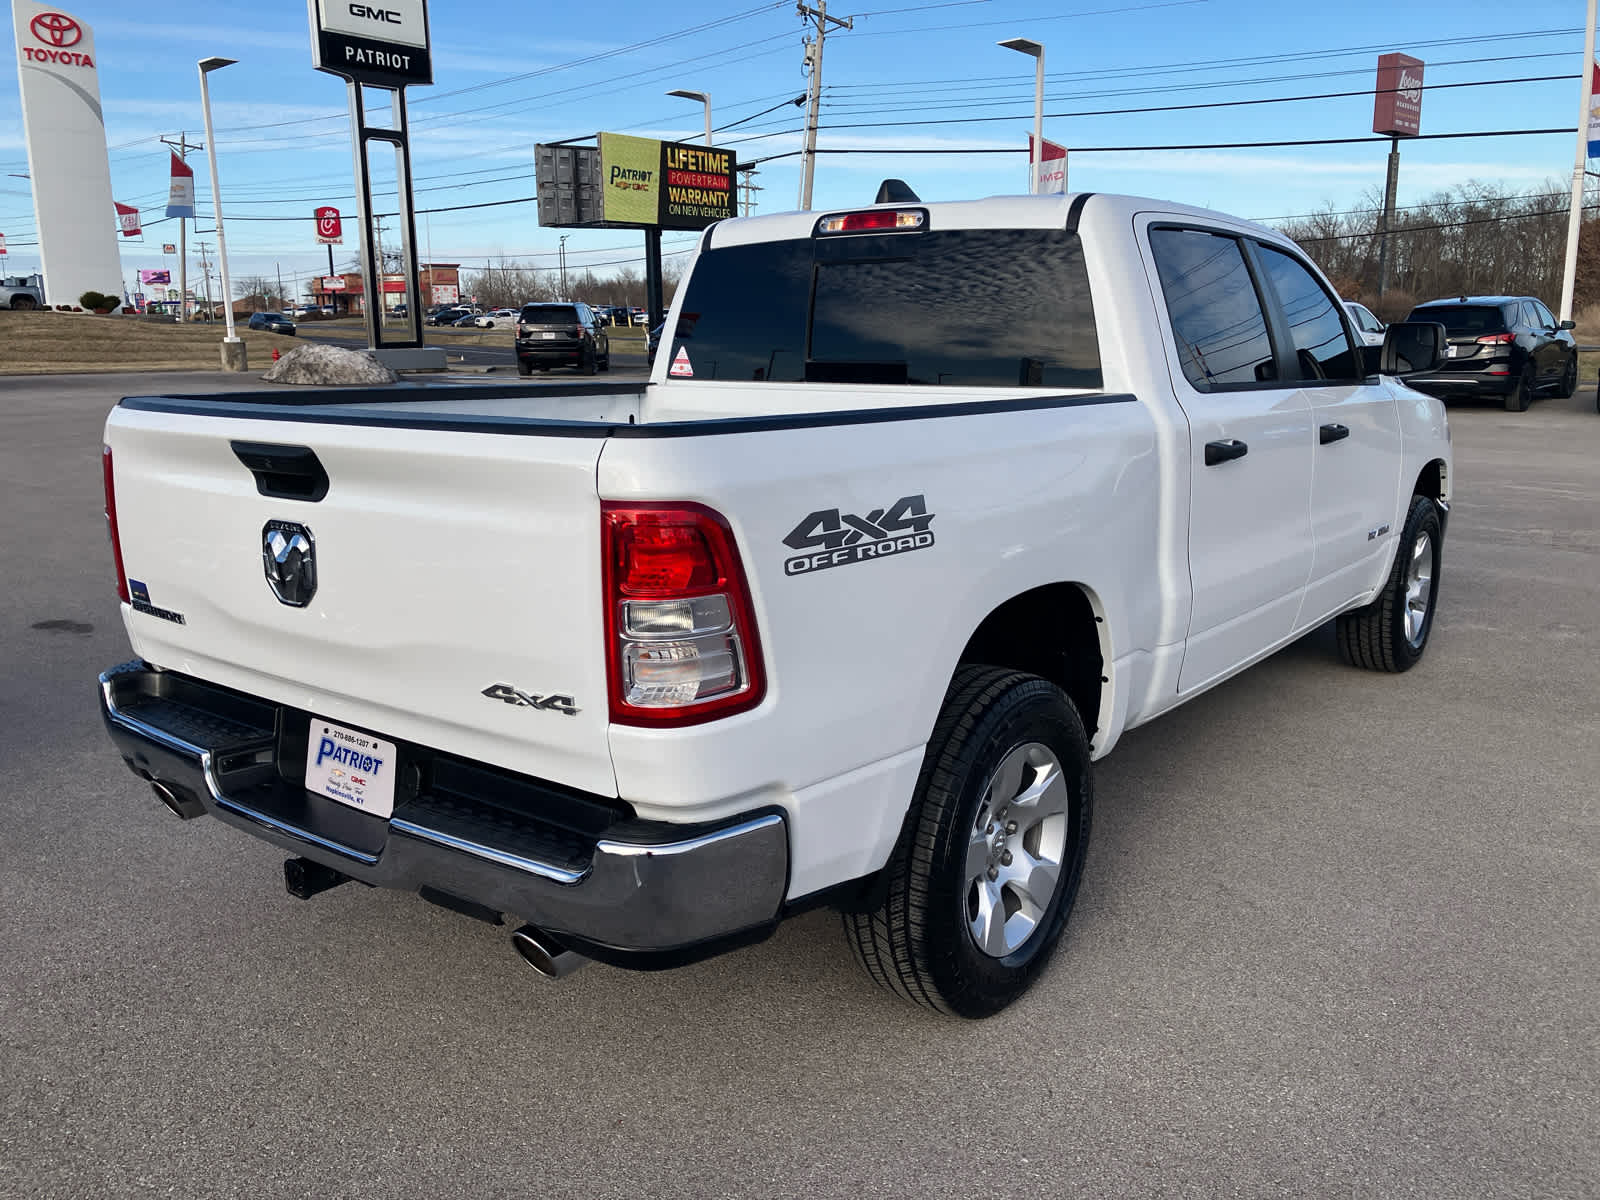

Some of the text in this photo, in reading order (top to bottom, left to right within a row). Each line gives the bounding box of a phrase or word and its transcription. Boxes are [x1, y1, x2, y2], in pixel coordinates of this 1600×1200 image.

[349, 4, 402, 24] GMC
[23, 47, 94, 68] TOYOTA
[345, 46, 411, 70] PATRIOT
[667, 147, 729, 174] LIFETIME
[671, 171, 728, 188] POWERTRAIN
[668, 187, 729, 207] WARRANTY
[668, 204, 731, 218] ON NEW VEHICLES
[787, 533, 932, 573] OFF ROAD
[350, 775, 367, 786] GMC
